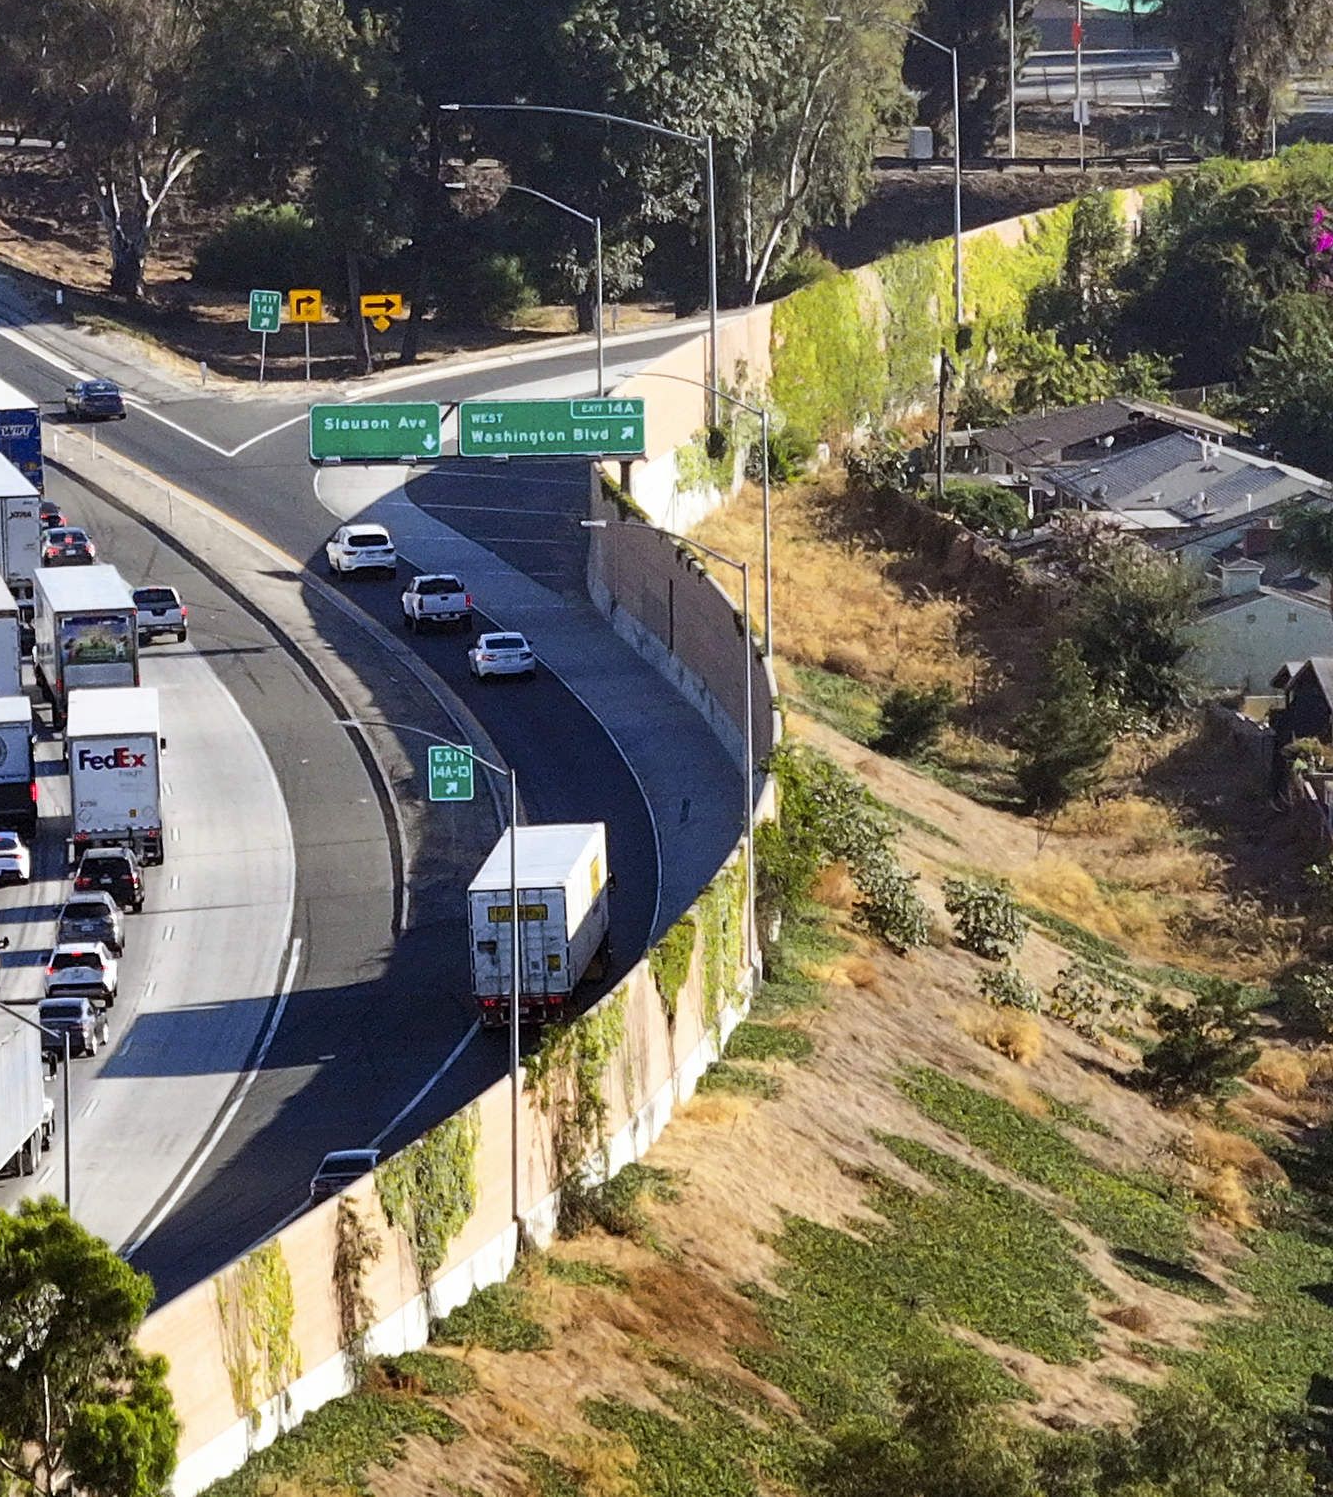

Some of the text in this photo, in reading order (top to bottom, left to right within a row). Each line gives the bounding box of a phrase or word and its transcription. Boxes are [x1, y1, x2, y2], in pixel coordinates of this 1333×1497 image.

[253, 293, 278, 303] EXIT
[257, 305, 273, 314] 14A
[581, 402, 634, 414] EXIT 14A
[324, 416, 427, 430] Slauson Ave
[471, 413, 503, 424] WEST
[471, 428, 609, 445] Washington Blvd
[78, 746, 147, 771] FedEx
[434, 751, 465, 763] EXIT
